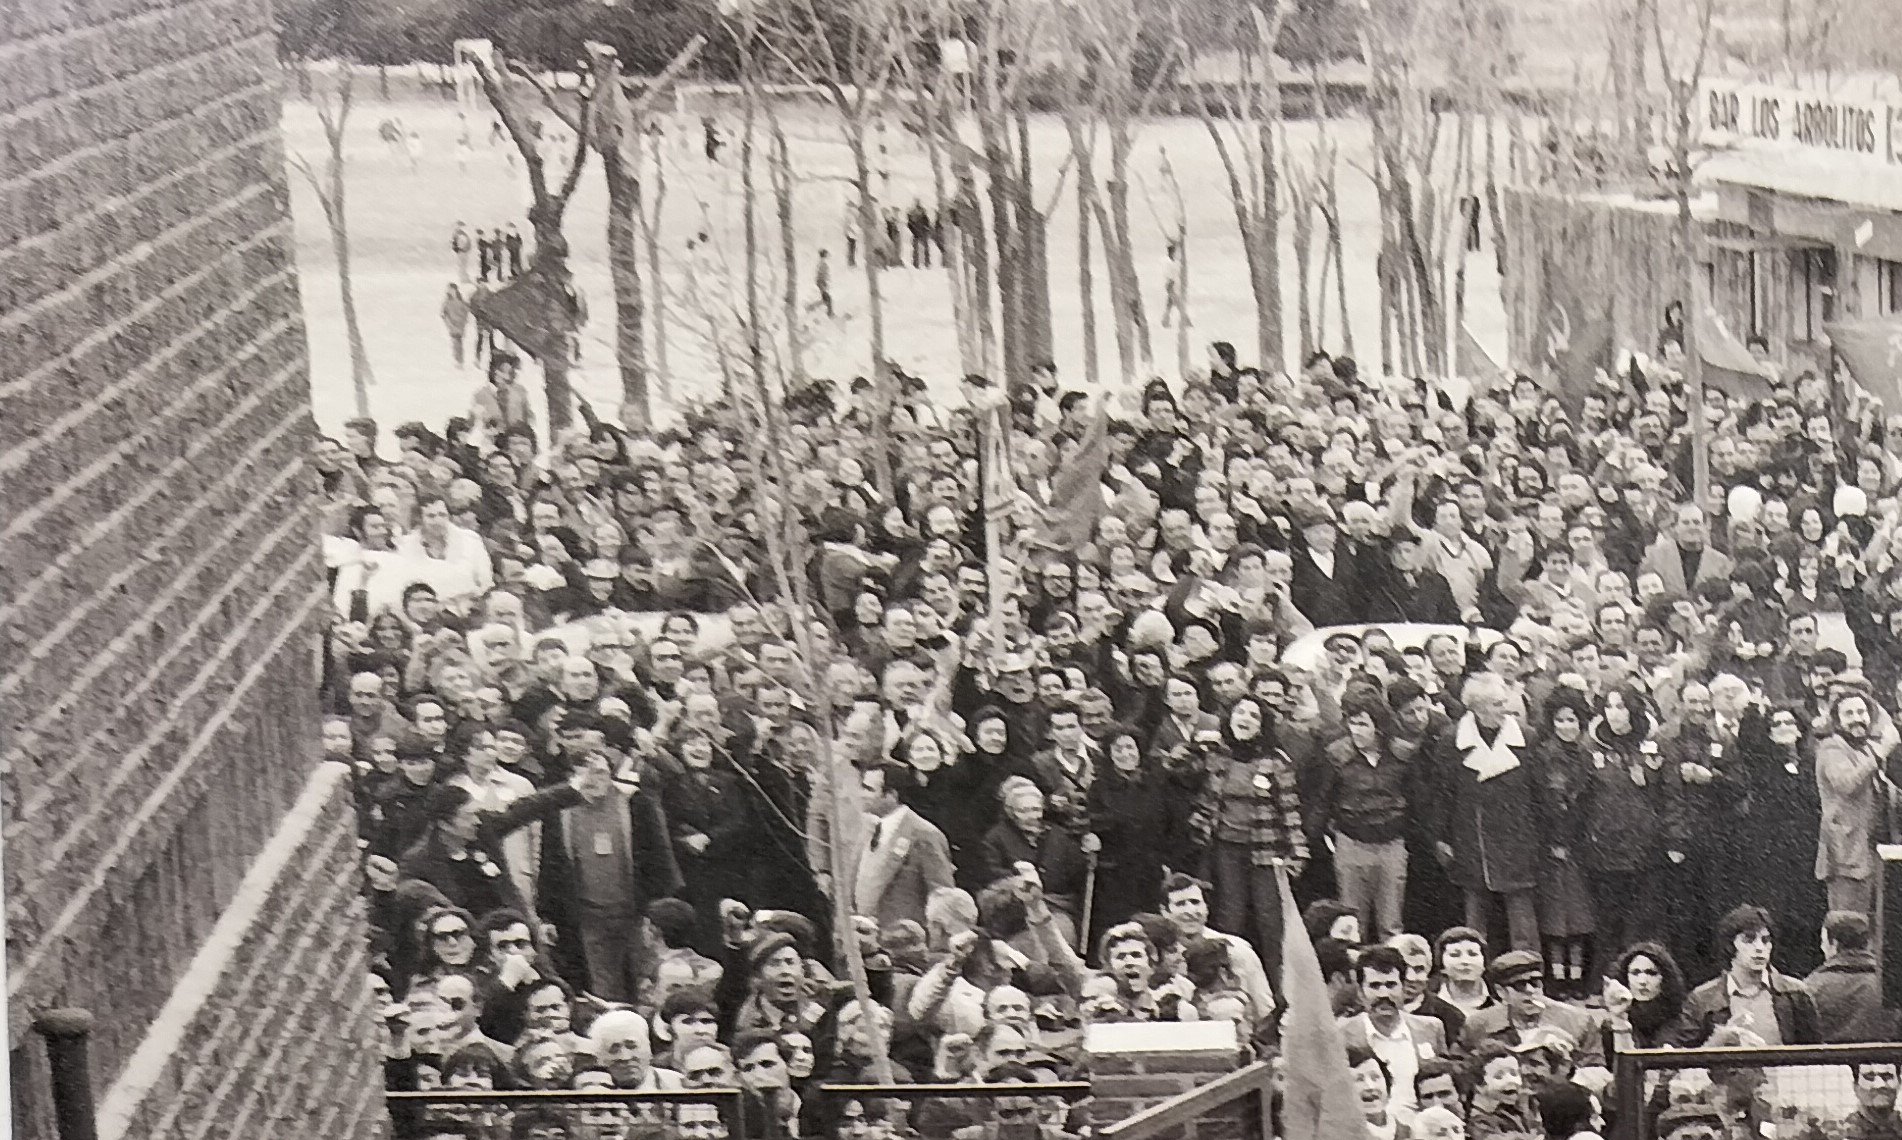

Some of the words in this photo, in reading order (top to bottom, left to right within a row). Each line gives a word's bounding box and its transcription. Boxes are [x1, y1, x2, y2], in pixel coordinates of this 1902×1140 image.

[1709, 89, 1740, 135] BAR
[1751, 95, 1781, 141] LOS
[1793, 98, 1876, 154] ARBOLITOS
